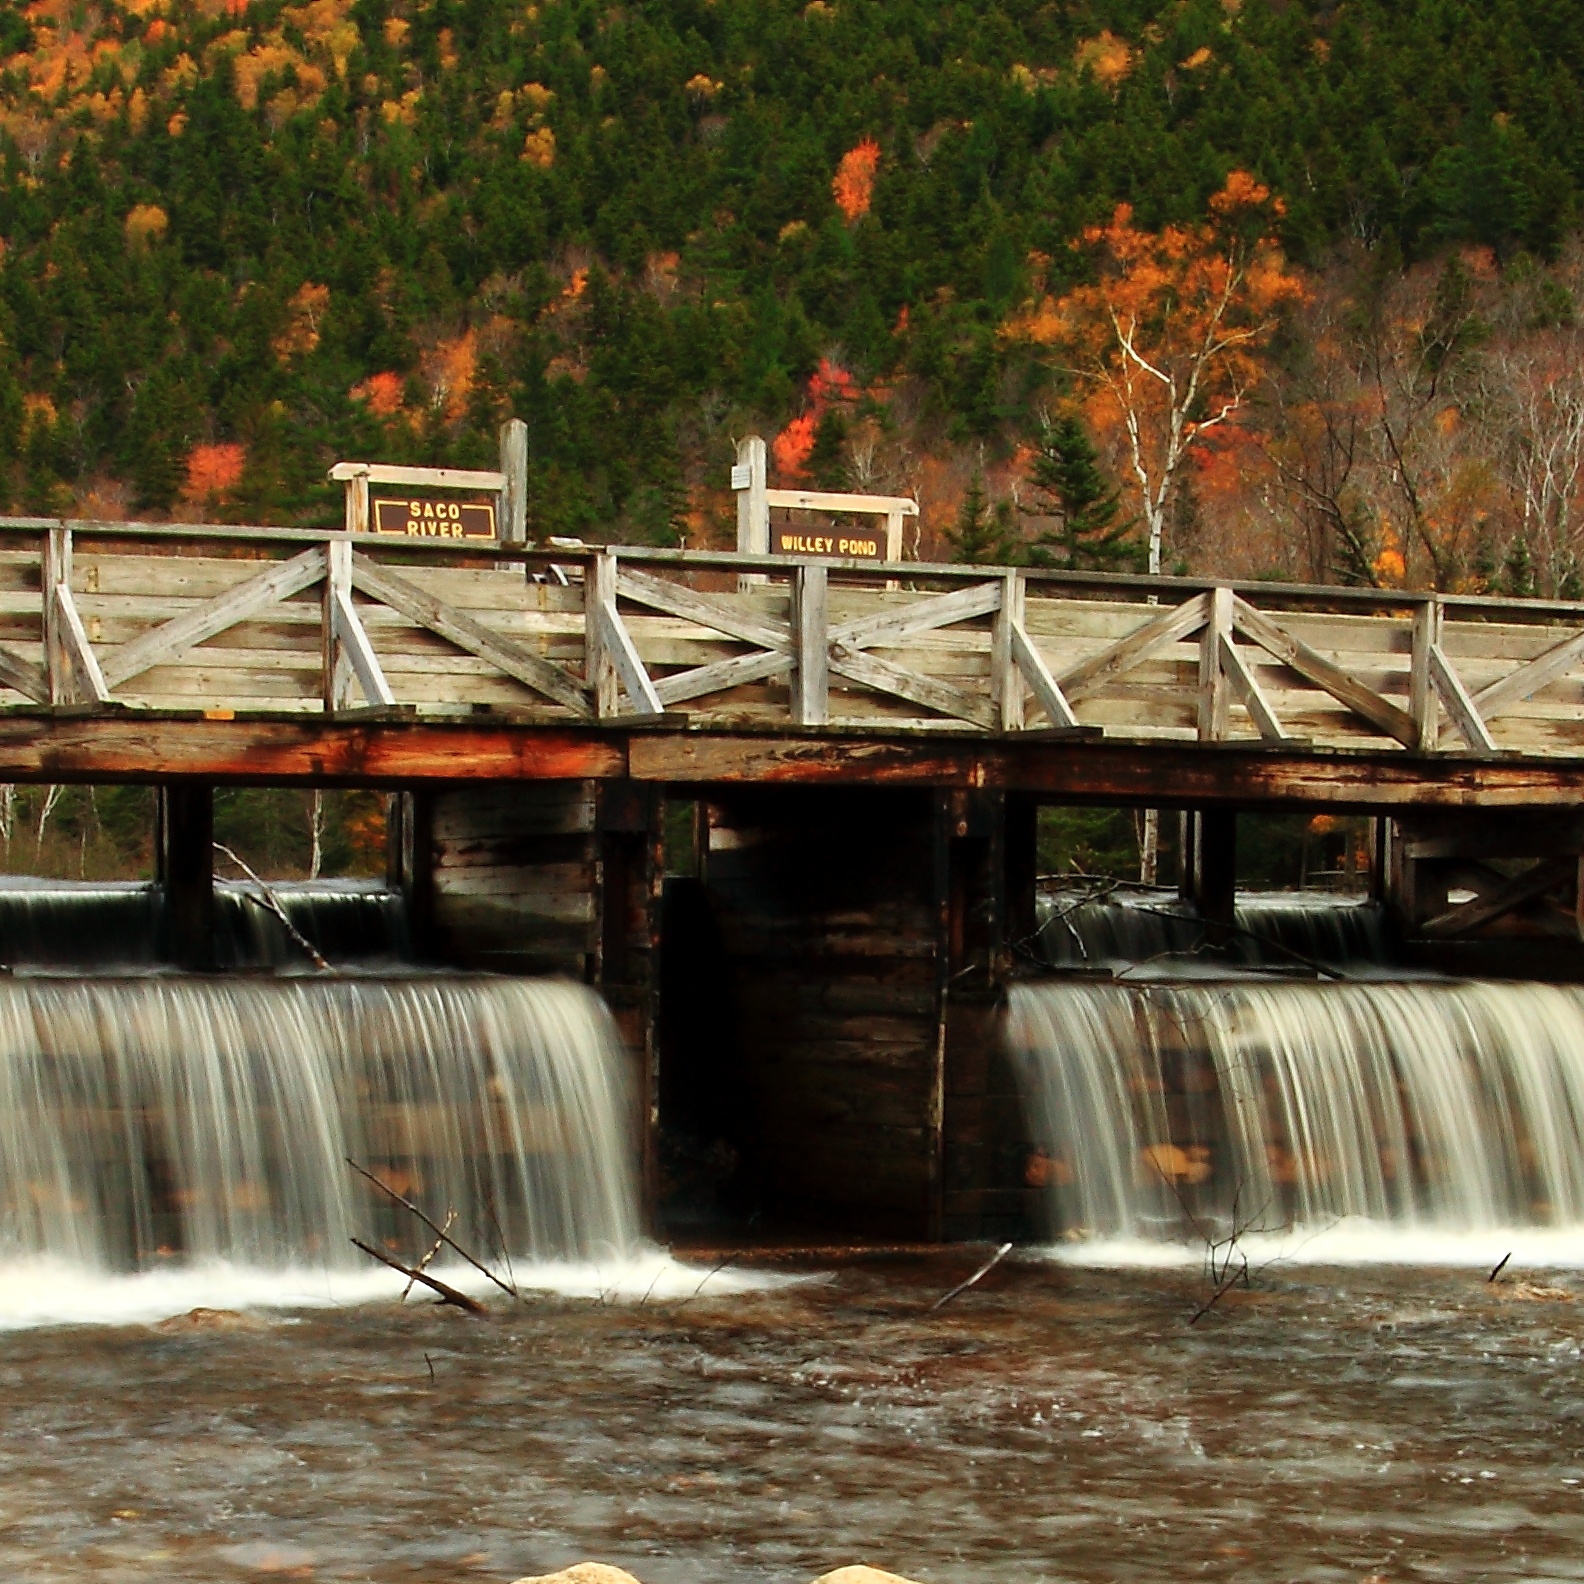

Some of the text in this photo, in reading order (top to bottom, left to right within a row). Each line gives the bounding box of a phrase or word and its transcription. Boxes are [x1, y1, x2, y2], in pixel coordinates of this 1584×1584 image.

[410, 501, 460, 519] SACO
[407, 521, 463, 538] RIVER
[781, 535, 877, 556] WILLEY POND
